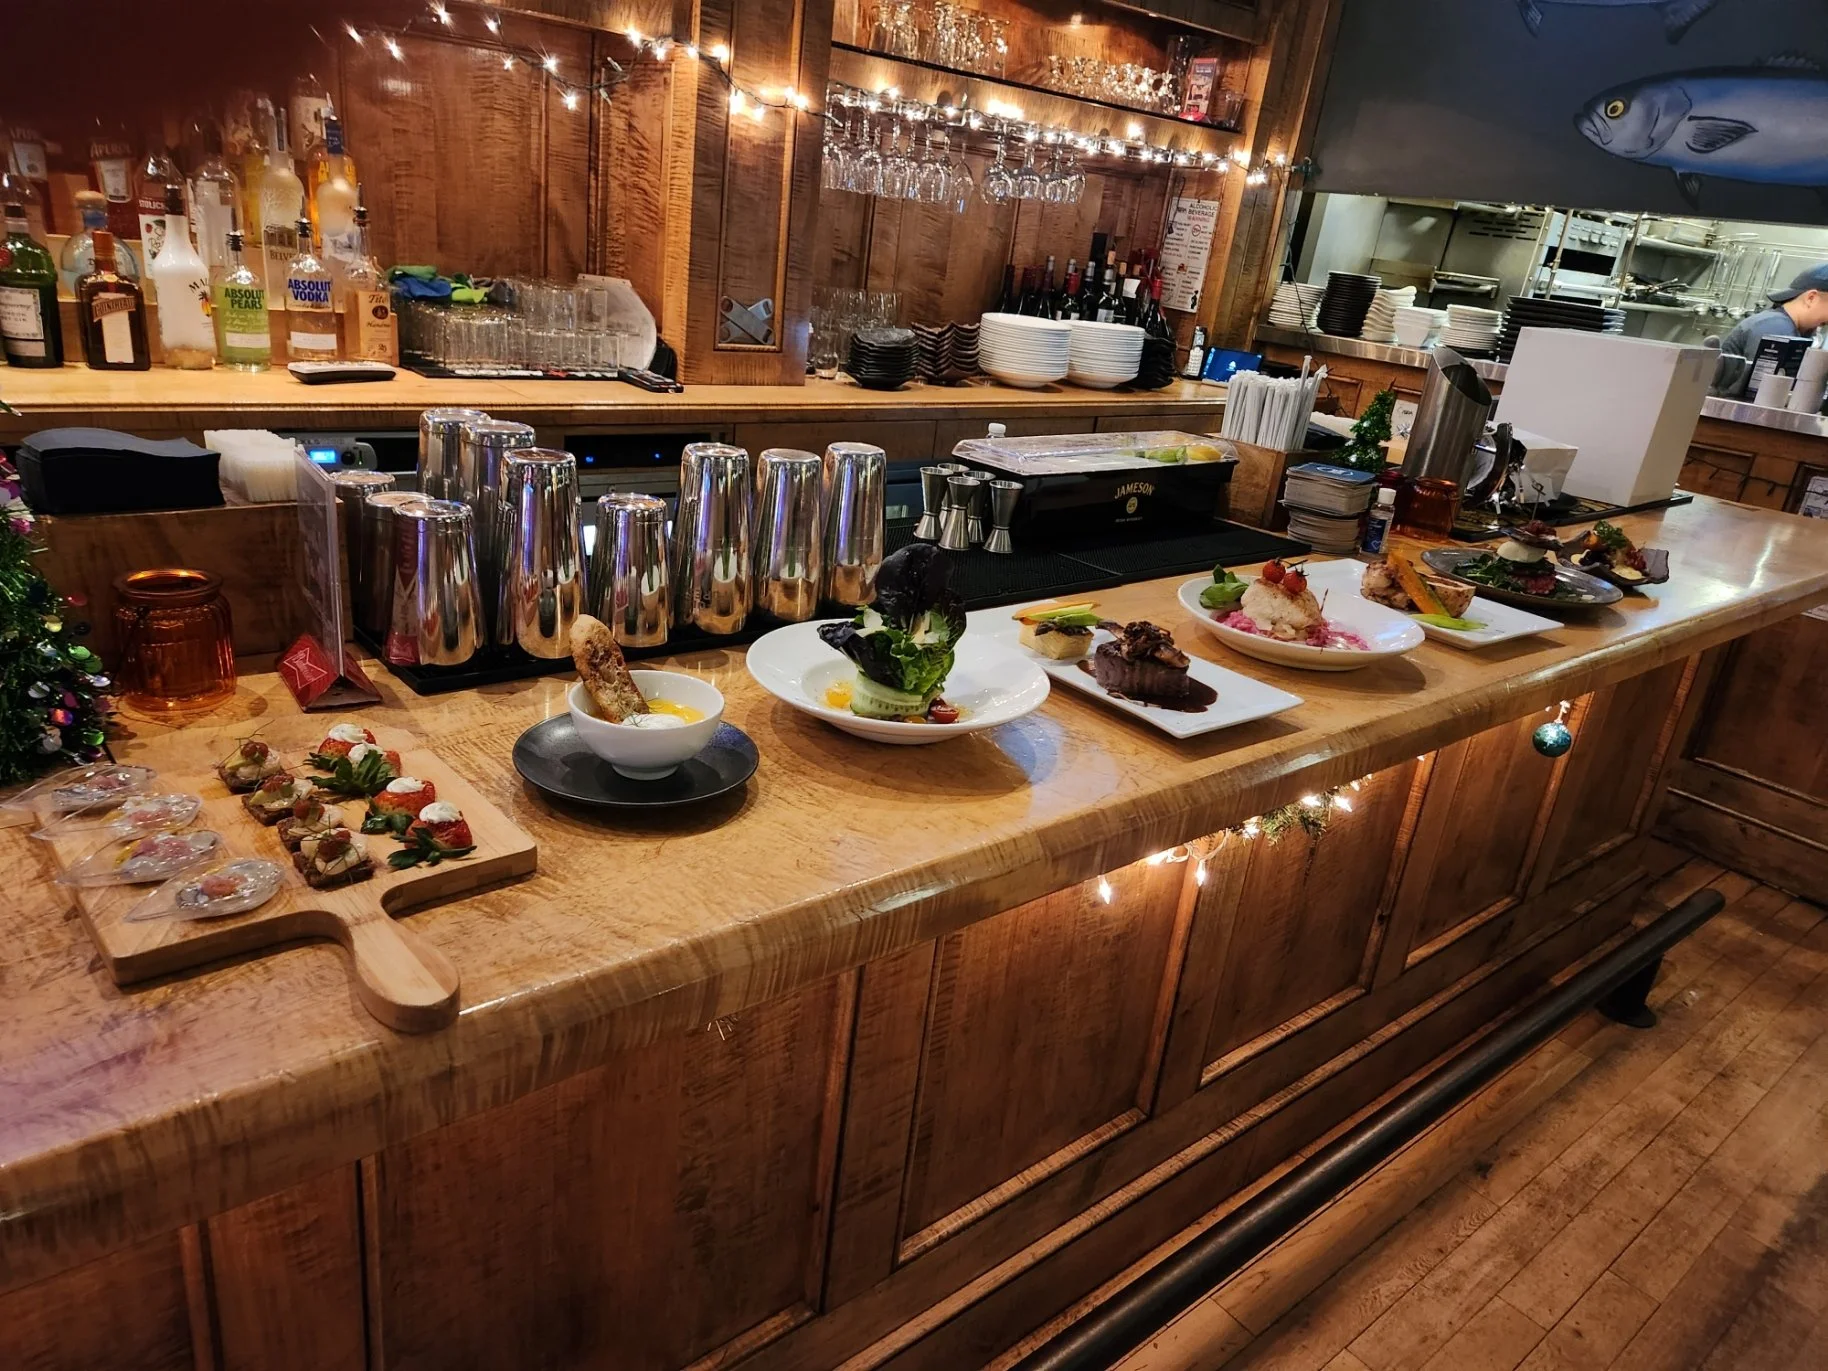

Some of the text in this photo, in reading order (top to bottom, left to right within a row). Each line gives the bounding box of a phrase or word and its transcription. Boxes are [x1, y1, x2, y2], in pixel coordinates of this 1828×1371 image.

[1187, 209, 1215, 218] BEVERAGE
[287, 278, 332, 293] ABSOLUT
[224, 287, 265, 300] ABSOLUT
[292, 290, 330, 303] VODKA
[230, 298, 263, 310] PEARS
[1114, 482, 1154, 499] JAMESON
